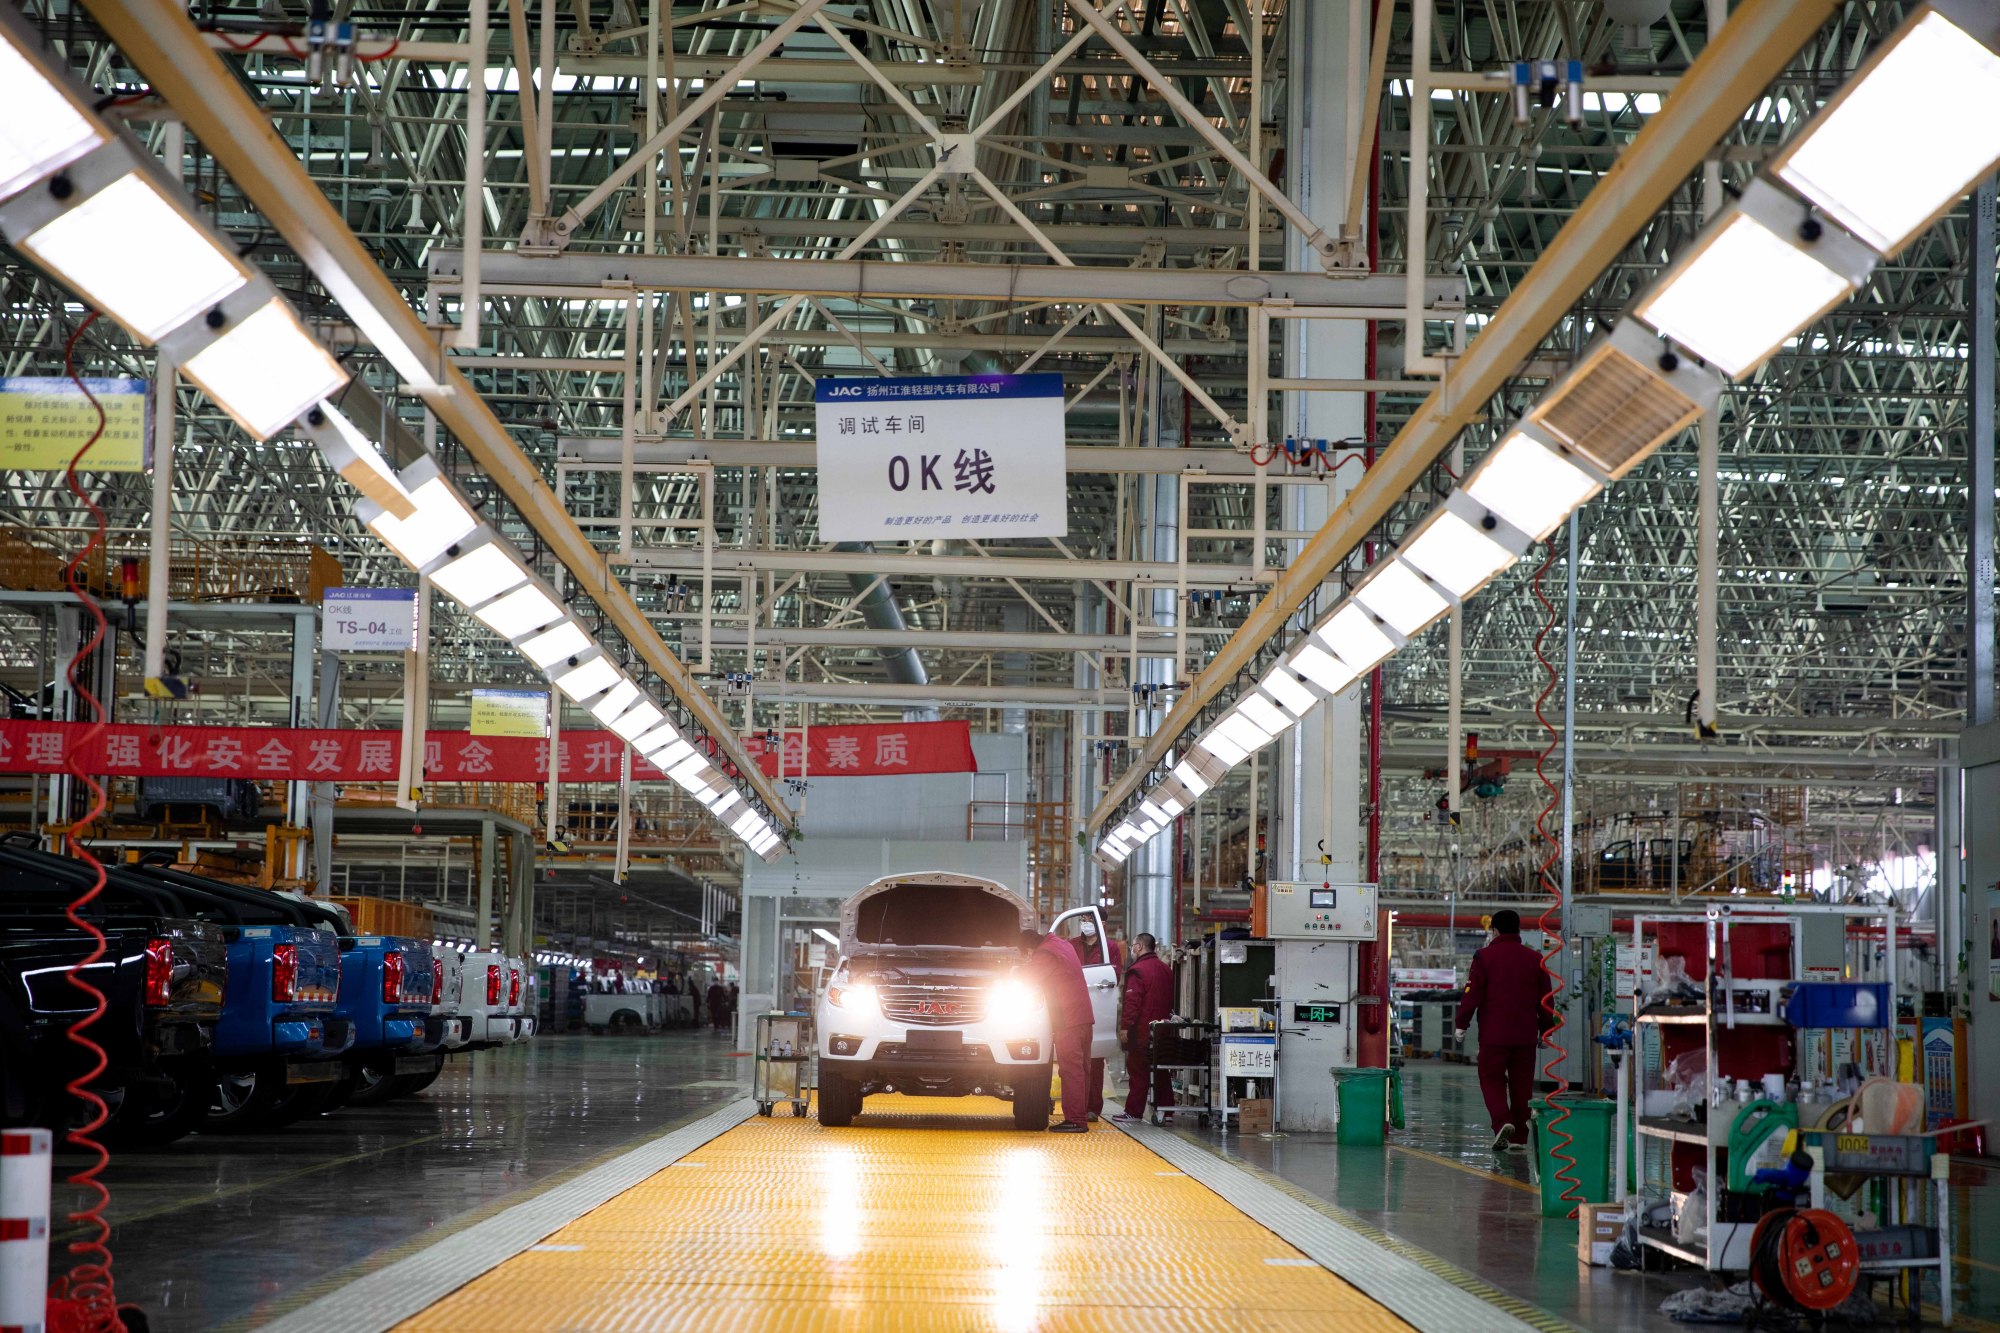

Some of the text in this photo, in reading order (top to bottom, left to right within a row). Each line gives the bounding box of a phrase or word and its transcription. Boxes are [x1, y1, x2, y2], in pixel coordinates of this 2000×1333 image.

[828, 383, 1001, 397] JAC 扬州江淮轻型汽车有限公司
[838, 415, 926, 435] 调试车间
[883, 512, 1040, 527] 制造更好的产品 创造更美好的社会
[328, 605, 352, 615] OK线
[336, 621, 387, 634] TS-04
[105, 734, 493, 774] 强化安全发展观念
[534, 733, 909, 773] 提升全素质
[910, 1000, 963, 1015] JAC
[1230, 1050, 1271, 1068] 检验工作台
